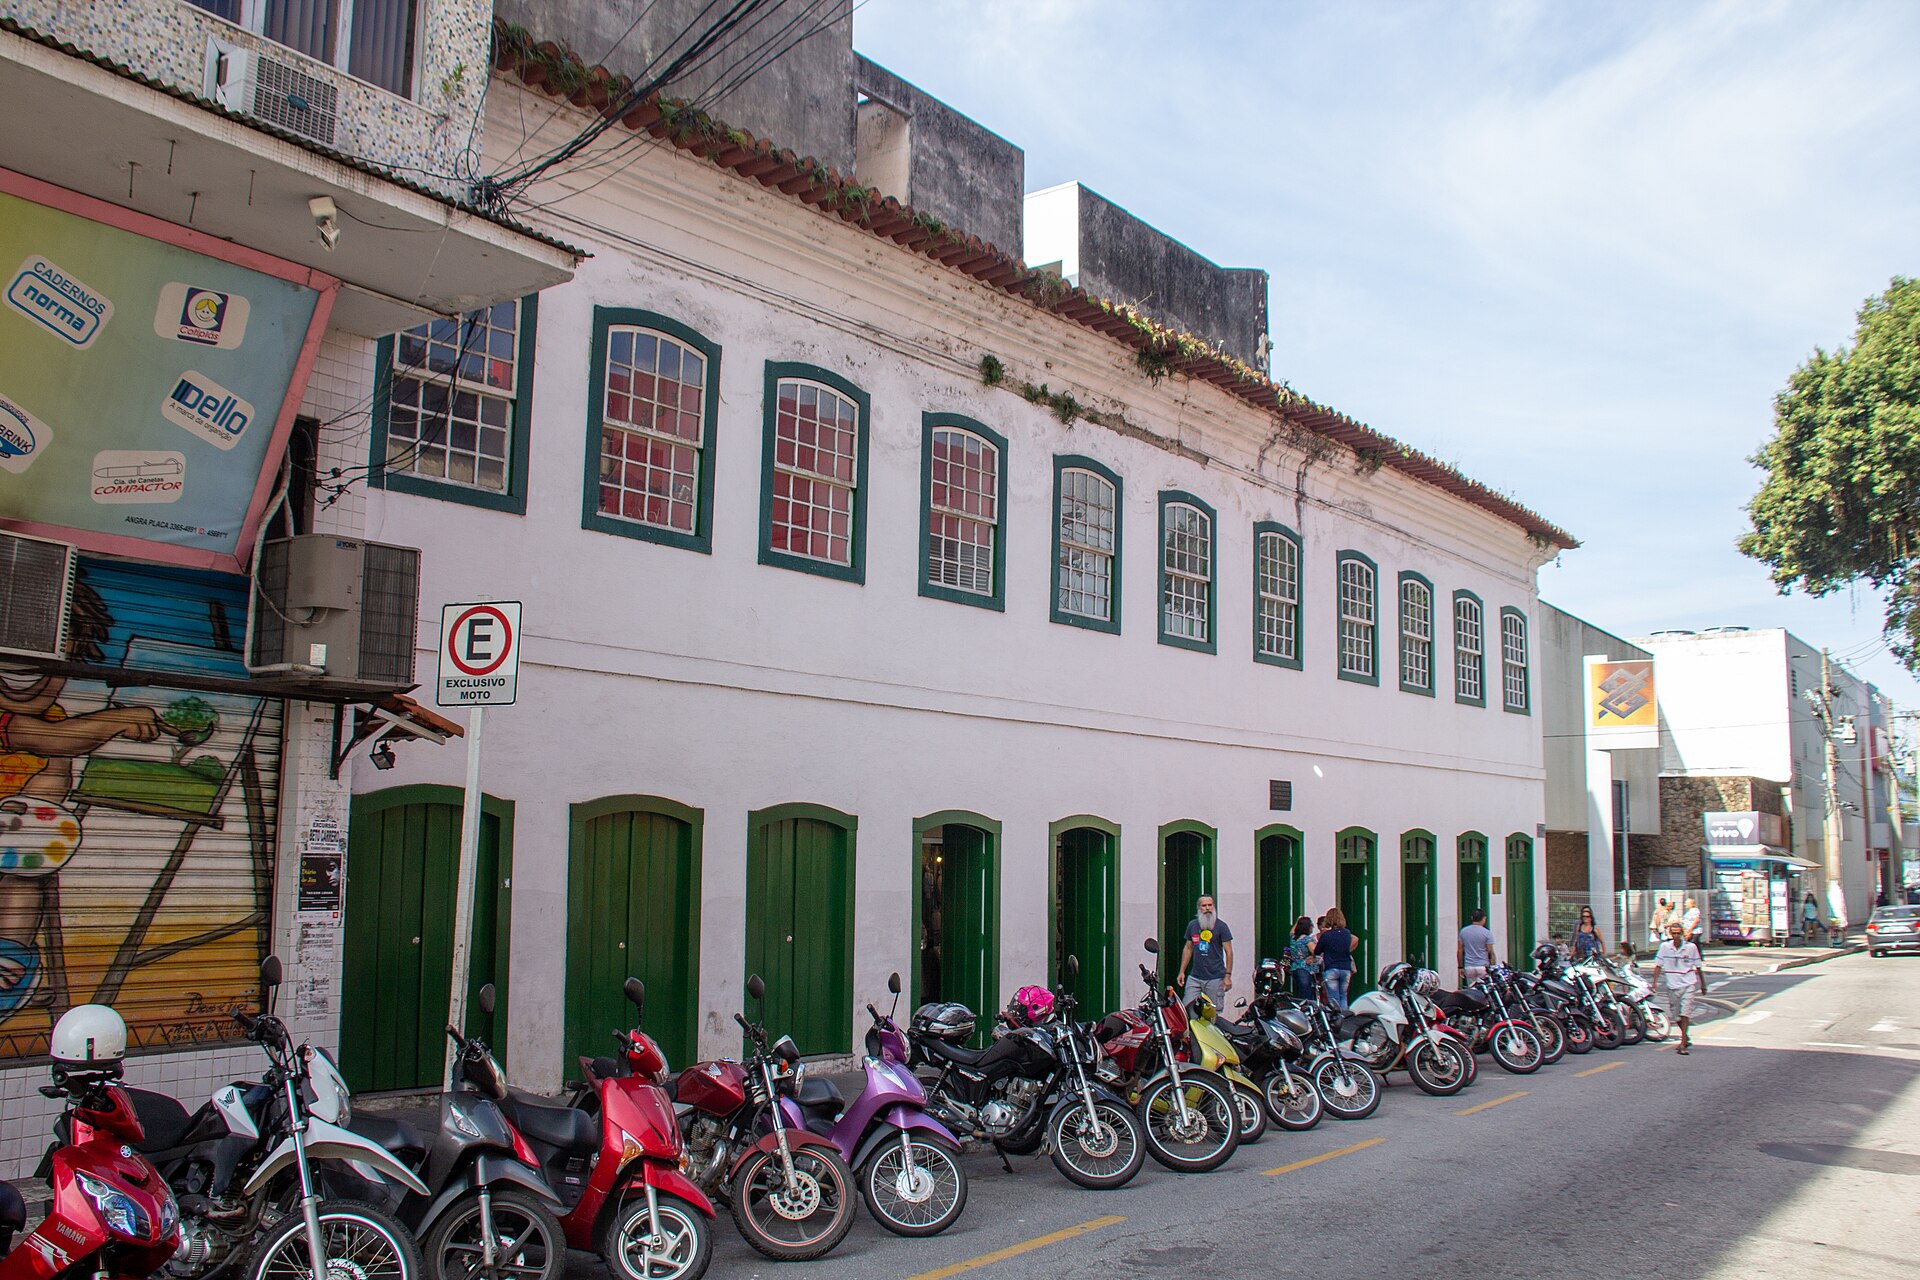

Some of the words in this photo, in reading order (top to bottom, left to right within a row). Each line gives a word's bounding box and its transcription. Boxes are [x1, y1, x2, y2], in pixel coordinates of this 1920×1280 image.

[33, 262, 106, 315] CADERNOS
[23, 285, 86, 332] norma
[171, 379, 248, 436] Dello
[94, 481, 182, 495] COMPACTOR
[125, 515, 148, 526] ANGRA
[148, 519, 169, 528] PLACA
[466, 618, 493, 660] E
[446, 678, 506, 688] EXCLUSIVO
[460, 691, 491, 700] MOTO
[1710, 826, 1740, 838] vivo
[56, 1222, 87, 1246] YAMAHA
